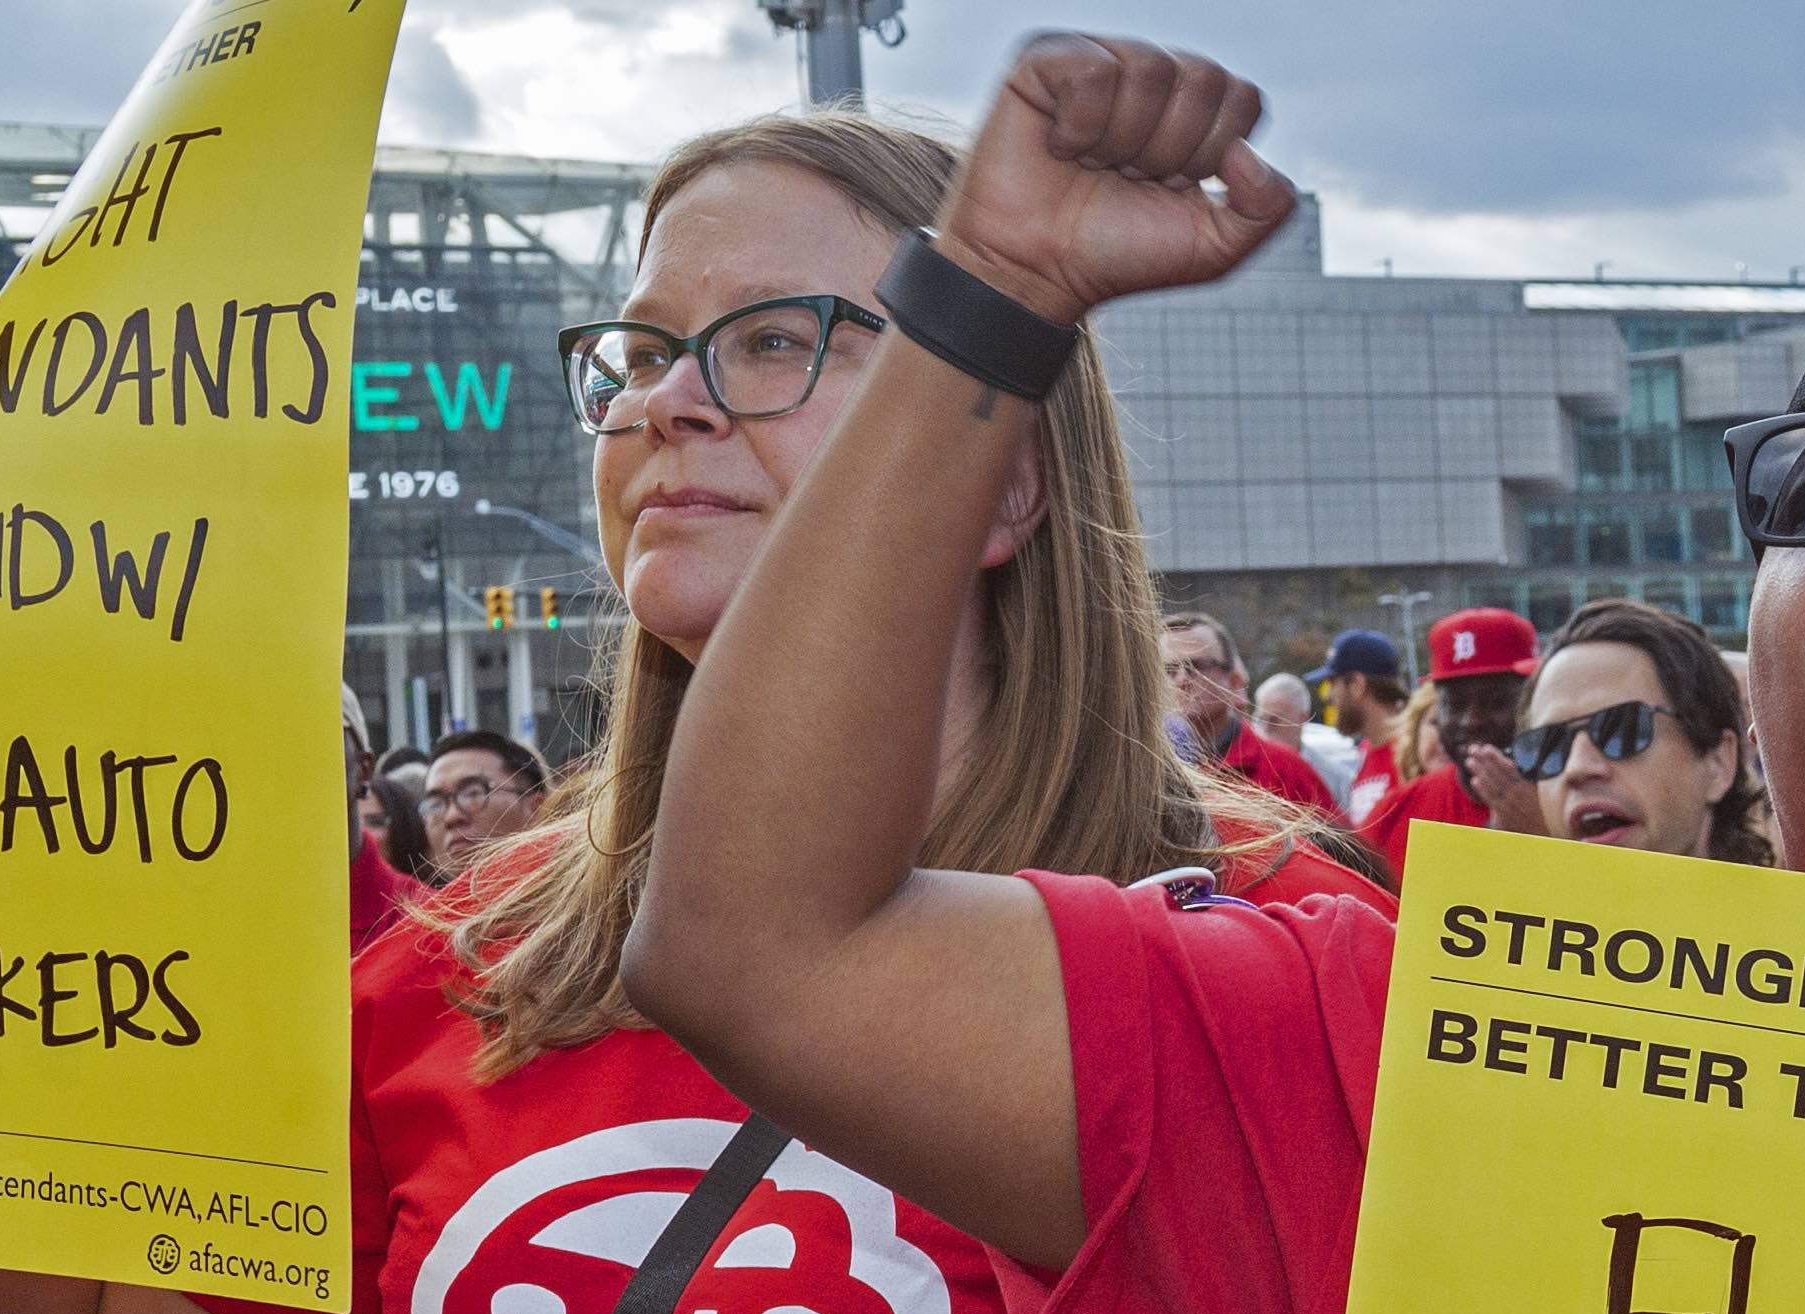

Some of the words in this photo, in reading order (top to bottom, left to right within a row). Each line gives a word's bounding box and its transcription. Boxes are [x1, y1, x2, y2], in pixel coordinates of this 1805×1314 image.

[379, 470, 460, 499] 1976
[89, 517, 209, 642] W/
[1427, 1009, 1748, 1109] BETTER
[206, 1191, 328, 1236] AFL-CIO
[188, 1242, 330, 1299] afacwa.org
